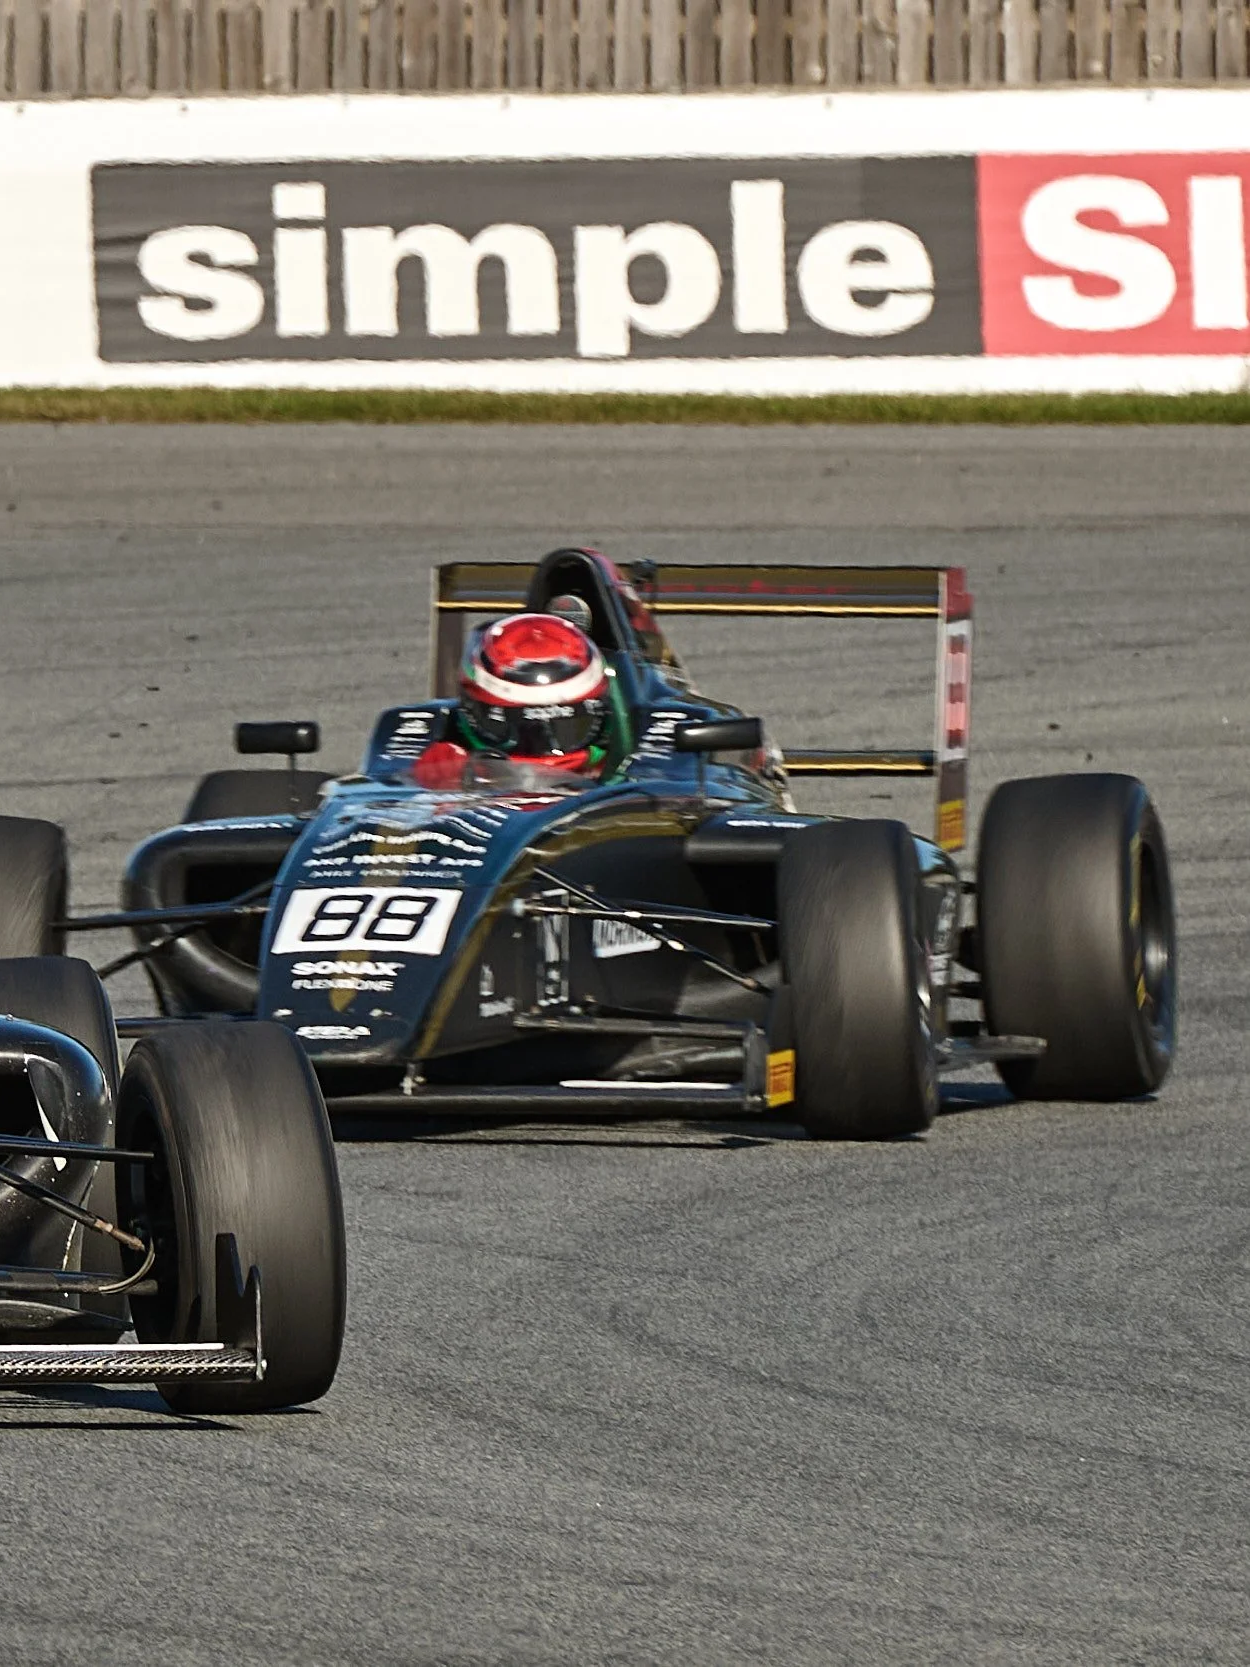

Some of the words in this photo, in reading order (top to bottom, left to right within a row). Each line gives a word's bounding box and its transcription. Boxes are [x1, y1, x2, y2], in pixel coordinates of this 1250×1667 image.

[137, 179, 936, 356] simple
[1020, 174, 1250, 331] SI
[301, 894, 438, 942] 88
[291, 960, 405, 976] SONAX
